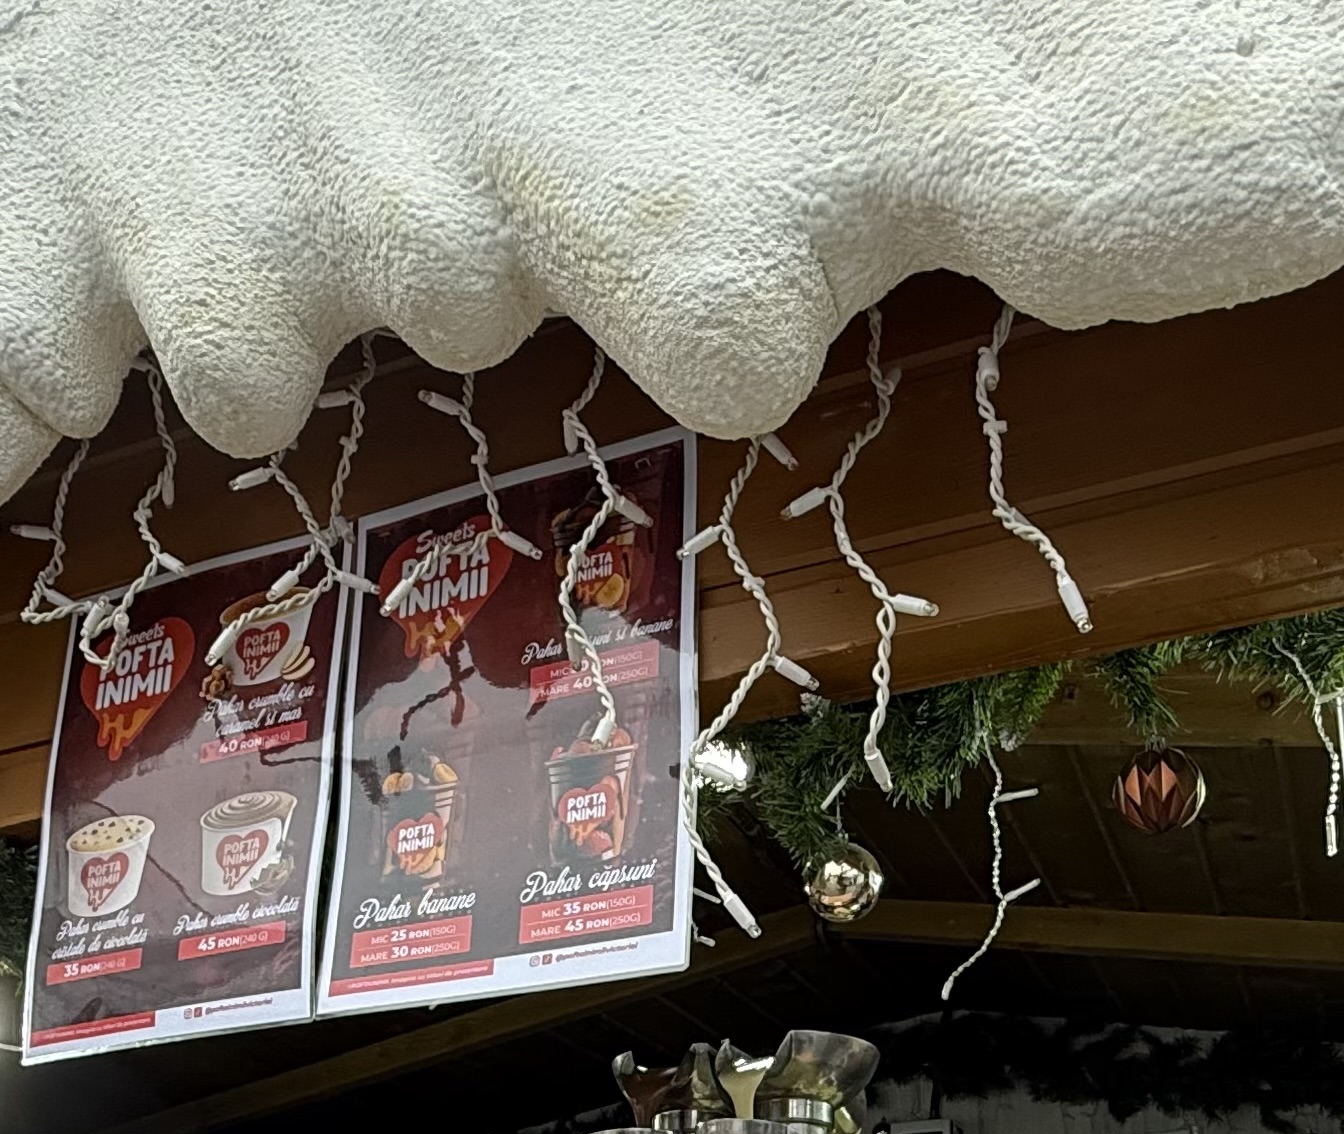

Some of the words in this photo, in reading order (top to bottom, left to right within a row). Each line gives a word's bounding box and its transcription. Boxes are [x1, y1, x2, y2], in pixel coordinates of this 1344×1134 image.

[416, 521, 476, 553] Sweets
[244, 629, 281, 647] POFTA
[521, 641, 562, 666] Pahar
[630, 618, 674, 638] banane
[243, 641, 279, 659] INIMII
[96, 664, 173, 710] INIMII
[298, 684, 315, 699] cu
[573, 677, 592, 689] 40
[218, 739, 237, 754] 40
[567, 792, 607, 811] POFTA
[566, 804, 606, 823] INIMII
[399, 823, 435, 841] POFTA
[224, 837, 260, 854] POFTA
[398, 837, 434, 854] INIMII
[223, 849, 258, 865] INIMII
[88, 860, 121, 877] POFTA
[87, 873, 120, 889] INIMII
[520, 867, 582, 903] Pahar
[588, 859, 658, 891] căpsuni
[354, 892, 411, 929] Pahar
[417, 889, 476, 916] banane
[541, 907, 561, 919] MIC
[563, 903, 581, 915] 35
[56, 917, 89, 941] Pahar
[173, 914, 208, 935] Pahar
[530, 925, 561, 938] MARE
[564, 919, 583, 932] 45
[197, 935, 216, 951] 45
[371, 933, 388, 945] MIC
[391, 930, 407, 942] 25
[360, 951, 388, 963] MARE
[391, 946, 409, 958] 30
[63, 964, 79, 978] 35
